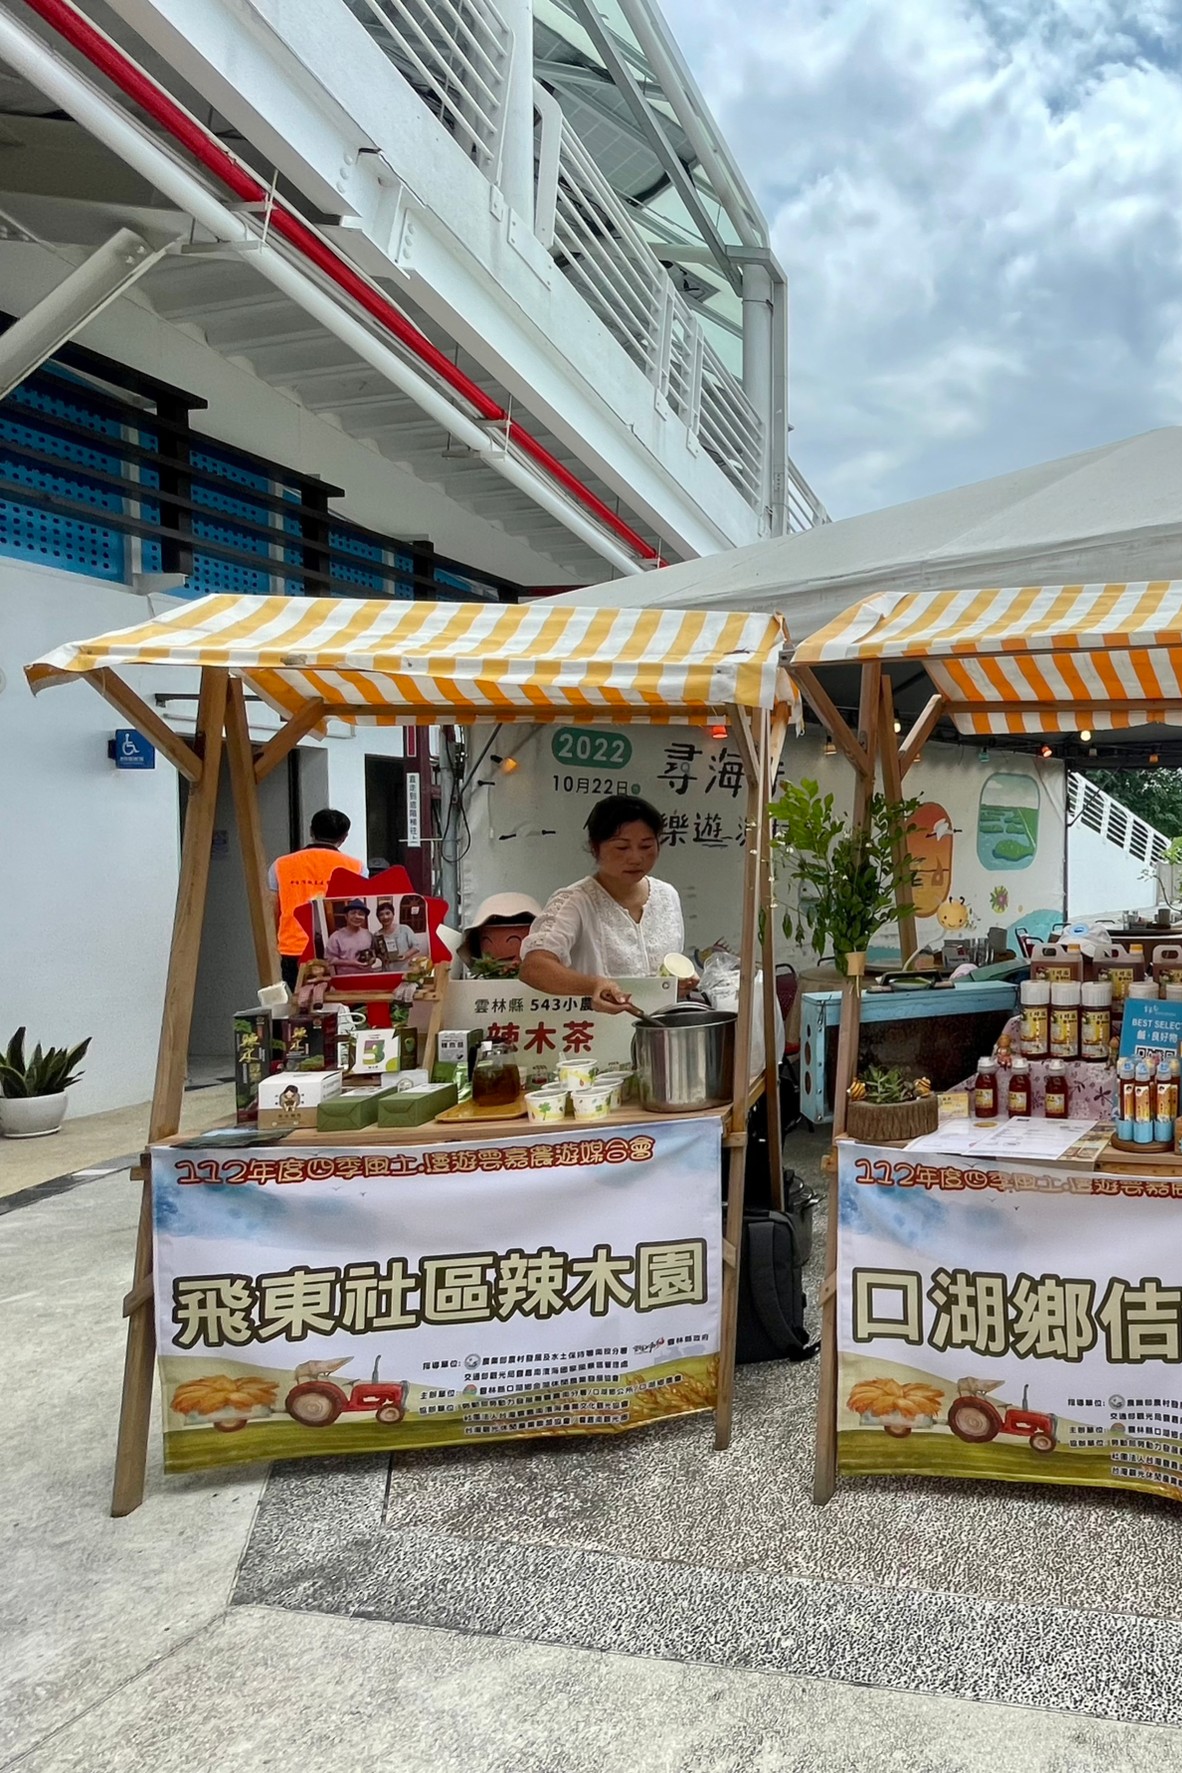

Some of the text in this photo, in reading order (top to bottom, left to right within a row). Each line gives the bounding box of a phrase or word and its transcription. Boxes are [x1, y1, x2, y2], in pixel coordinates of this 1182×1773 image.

[558, 734, 624, 762] 2022
[553, 775, 629, 796] 10月22日
[474, 996, 594, 1013] 雲林縣 543小農
[1132, 1018, 1152, 1027] BEST
[486, 1021, 595, 1054] 辣木茶
[172, 1238, 708, 1348] 飛東社區辣木園
